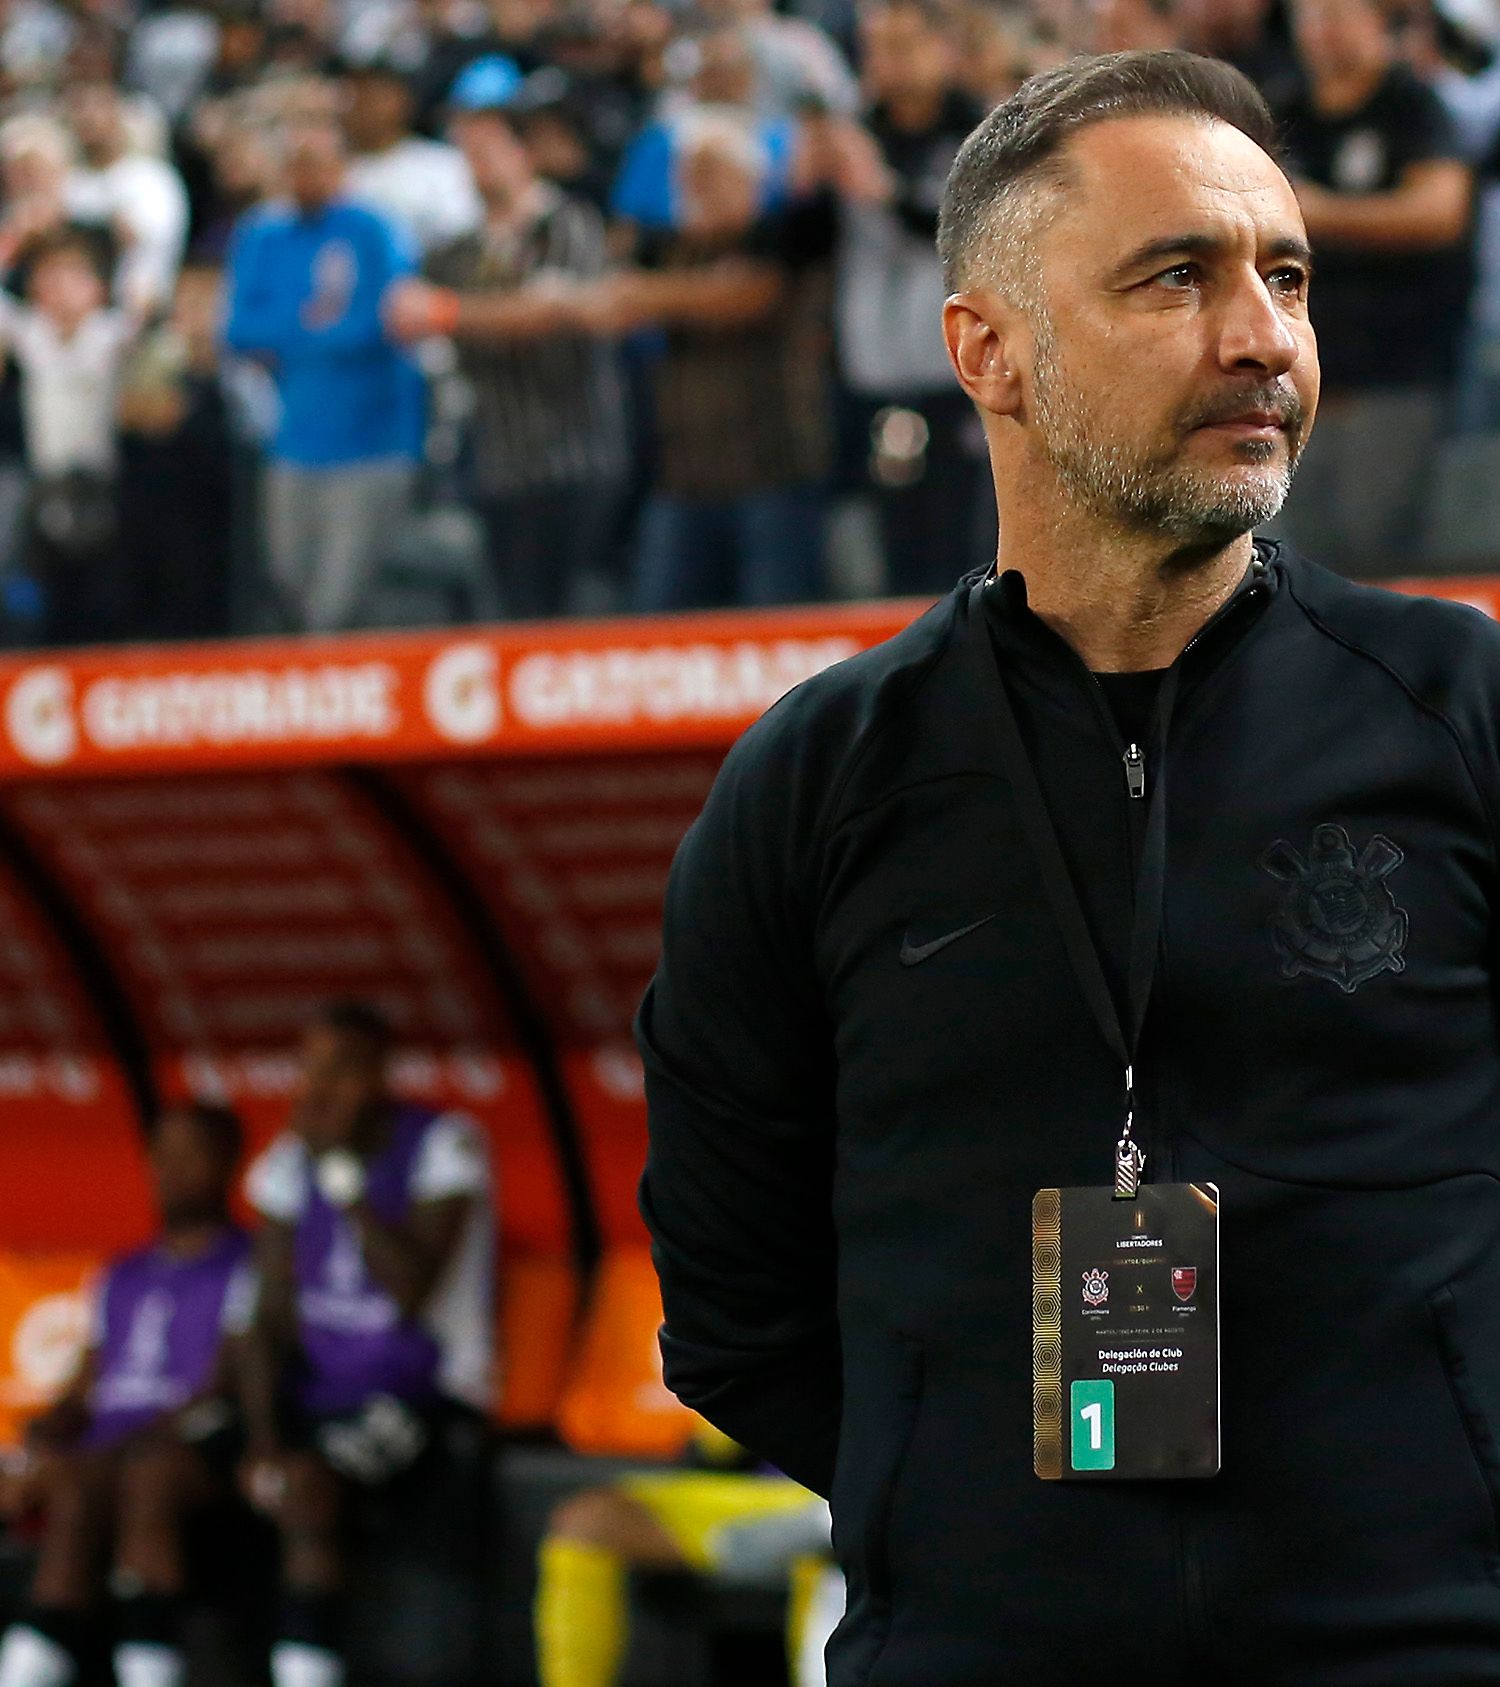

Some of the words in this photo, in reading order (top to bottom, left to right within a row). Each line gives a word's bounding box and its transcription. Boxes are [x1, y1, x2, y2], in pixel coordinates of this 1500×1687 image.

[1116, 1239, 1163, 1249] LIBERTADORES
[1098, 1348, 1148, 1361] Delegación
[1149, 1348, 1161, 1359] de
[1162, 1347, 1183, 1358] Club
[1102, 1362, 1148, 1374] Delegação
[1149, 1361, 1179, 1372] Clubes
[1080, 1403, 1102, 1449] 1
